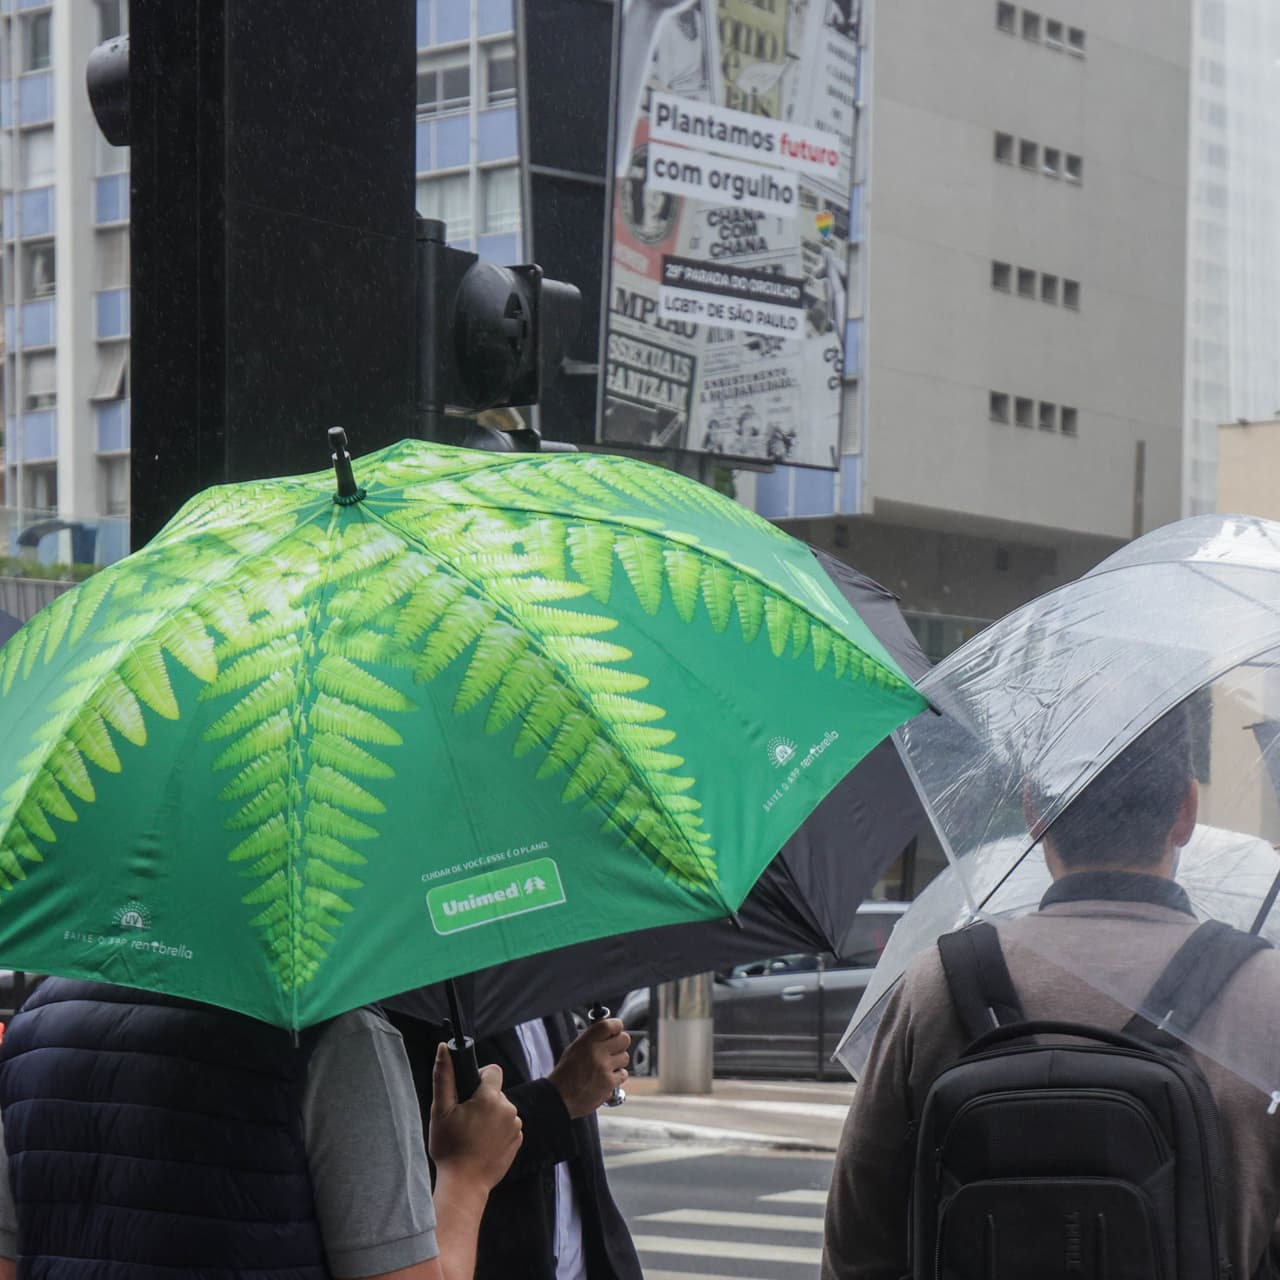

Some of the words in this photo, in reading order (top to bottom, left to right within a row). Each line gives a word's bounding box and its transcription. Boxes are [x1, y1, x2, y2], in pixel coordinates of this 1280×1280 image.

[656, 102, 775, 151] Plantamos
[779, 132, 839, 167] futuro
[654, 157, 702, 185] com
[708, 168, 793, 204] orgulho
[709, 236, 768, 257] CHANA
[719, 222, 758, 240] COM
[684, 267, 729, 288] PARADA
[731, 275, 748, 289] DO
[750, 278, 800, 299] ORGULHO
[665, 296, 704, 312] LGBT+
[708, 303, 724, 318] DE
[728, 303, 753, 323] SÃO
[757, 311, 798, 331] PAULO
[421, 868, 451, 882] CUIDAR
[451, 864, 463, 875] DE
[486, 852, 507, 864] ESSE
[514, 848, 520, 856] O
[442, 882, 519, 916] Unimed
